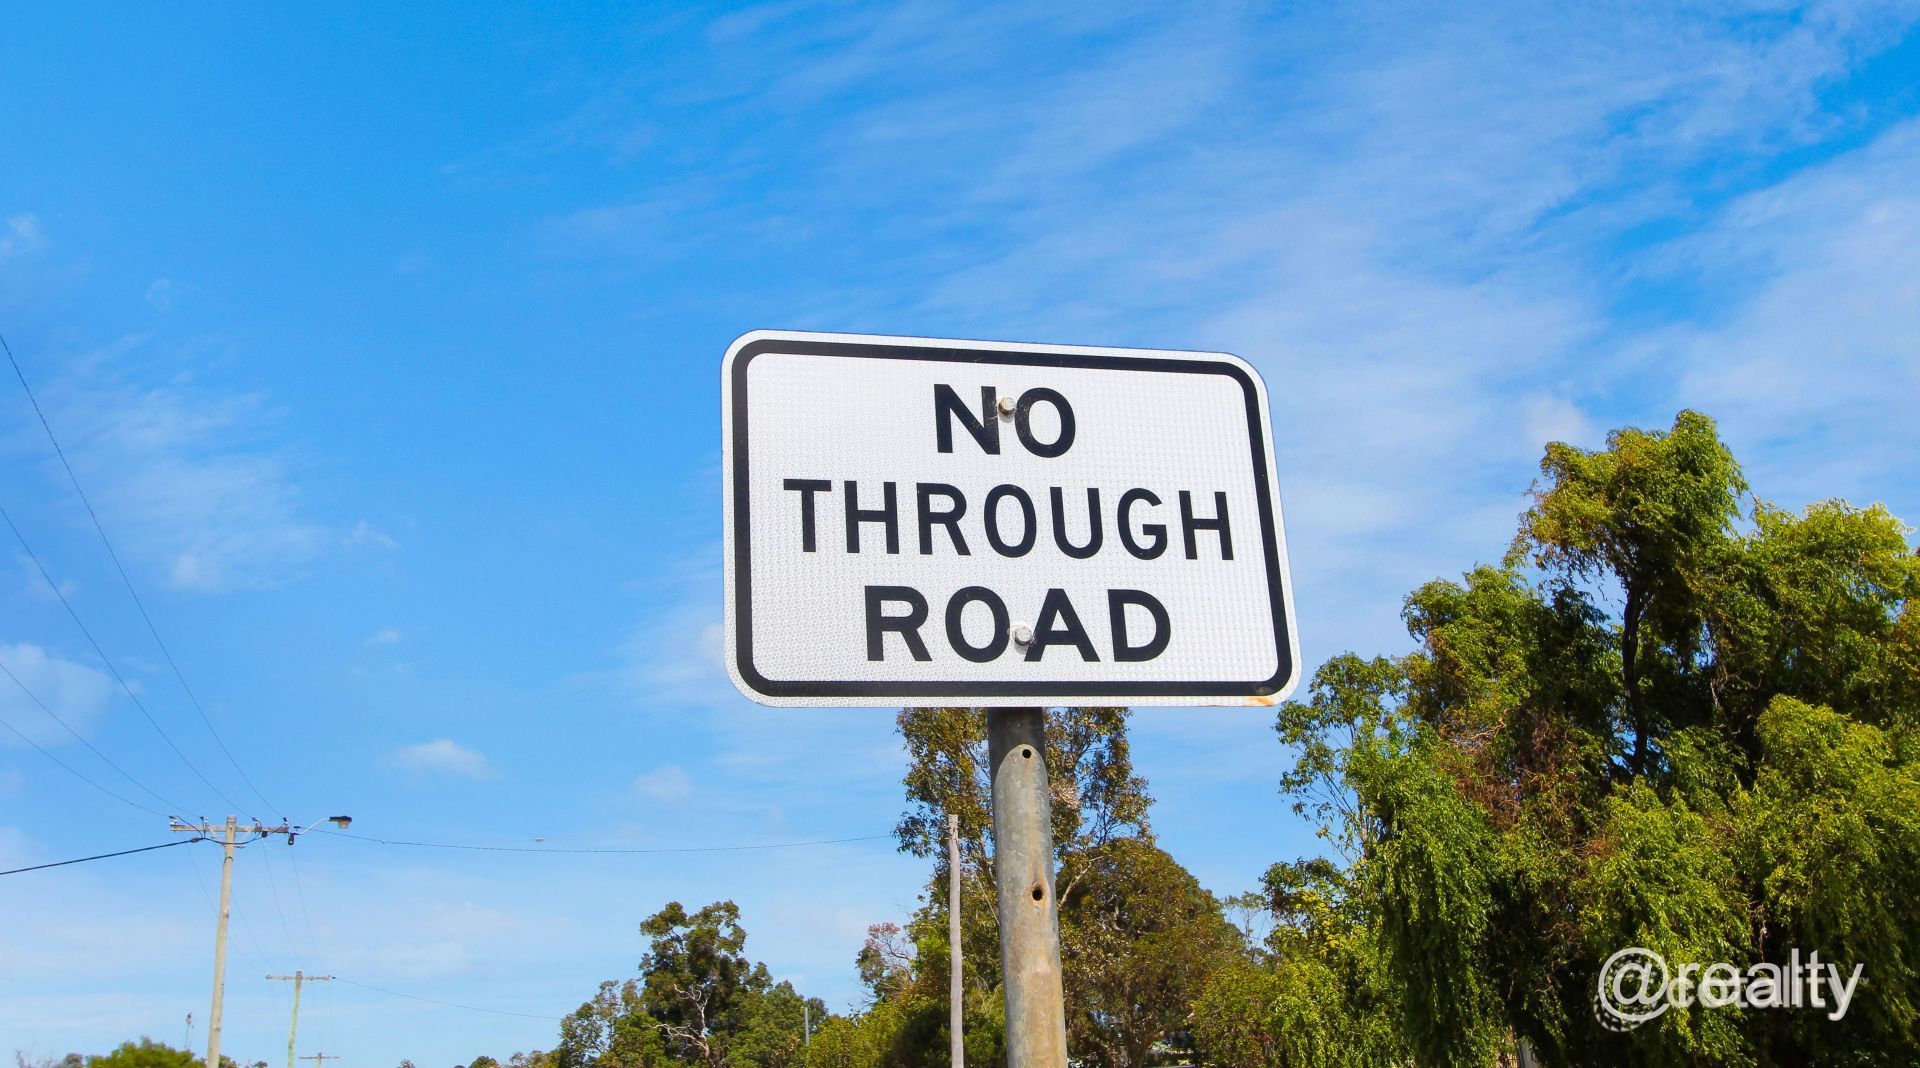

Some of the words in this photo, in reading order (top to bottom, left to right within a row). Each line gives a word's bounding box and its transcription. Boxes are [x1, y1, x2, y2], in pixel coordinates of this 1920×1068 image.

[934, 383, 1076, 459] NO
[783, 478, 1234, 561] THROUGH
[864, 585, 1171, 663] ROAD
